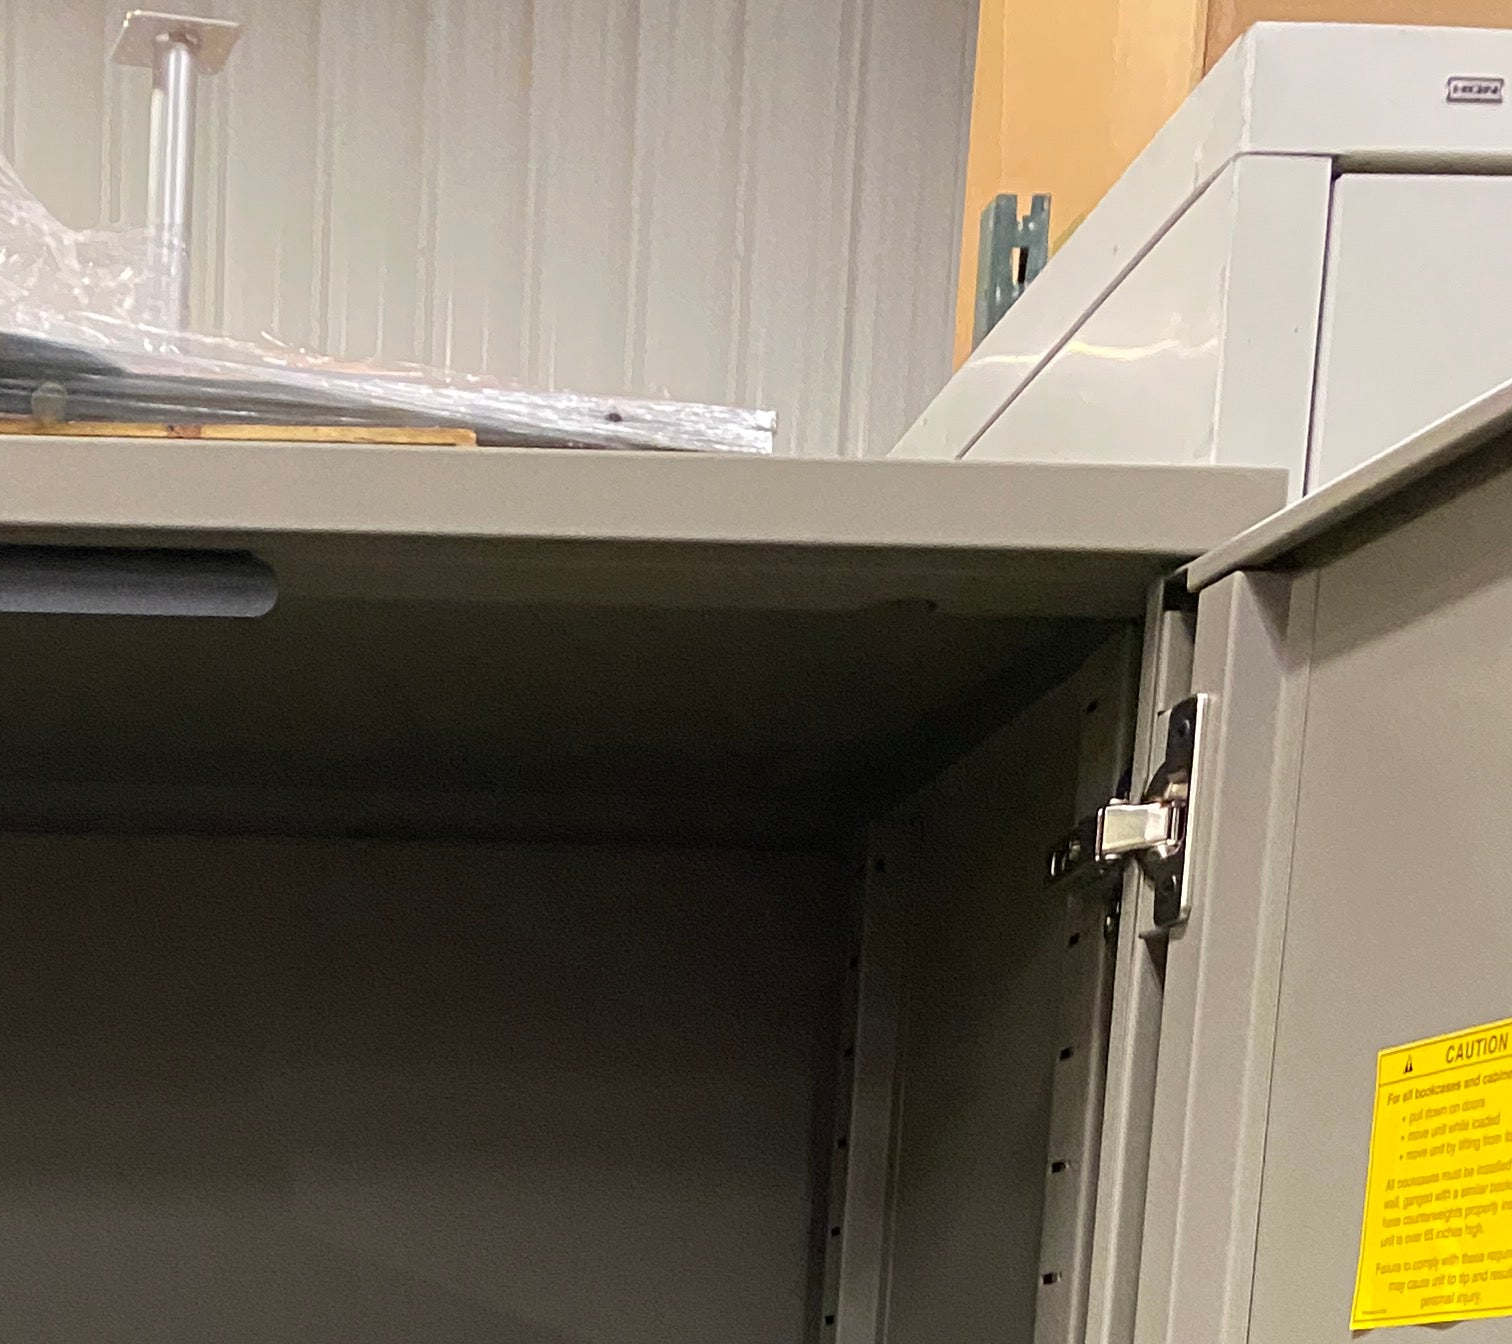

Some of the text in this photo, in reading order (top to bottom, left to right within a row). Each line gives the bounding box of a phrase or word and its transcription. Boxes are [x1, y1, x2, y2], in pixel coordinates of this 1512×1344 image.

[1446, 1032, 1508, 1063] CAUTION
[1387, 1093, 1400, 1106] For
[1403, 1088, 1413, 1102] all
[1415, 1081, 1461, 1099] bookcases
[1464, 1074, 1480, 1089] and
